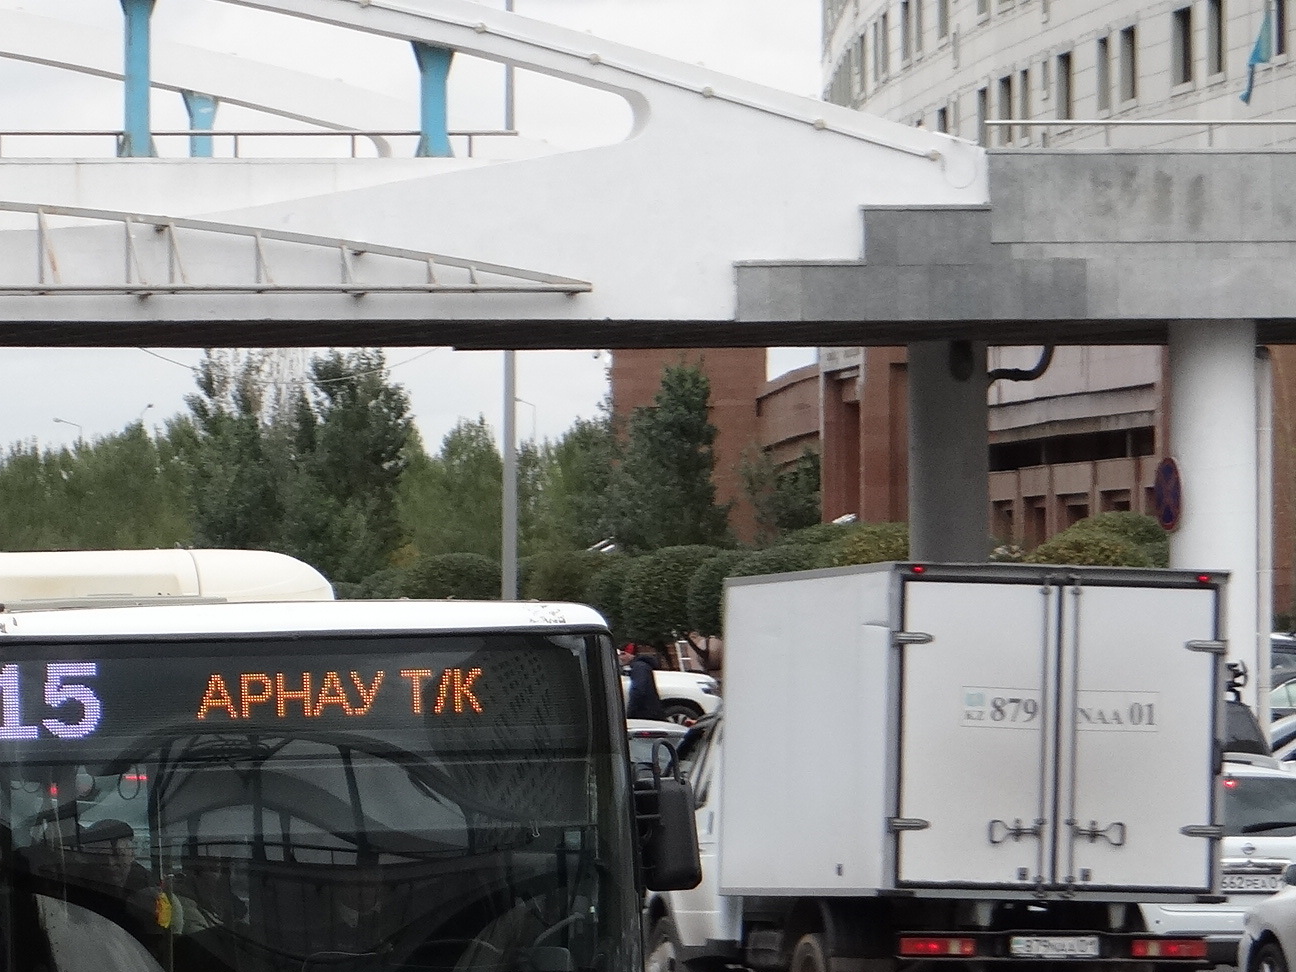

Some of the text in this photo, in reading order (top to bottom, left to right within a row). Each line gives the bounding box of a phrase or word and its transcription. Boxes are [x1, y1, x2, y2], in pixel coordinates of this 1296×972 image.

[197, 667, 483, 719] АРНАУ Т/К
[990, 696, 1038, 723] 879
[1128, 702, 1158, 726] 01
